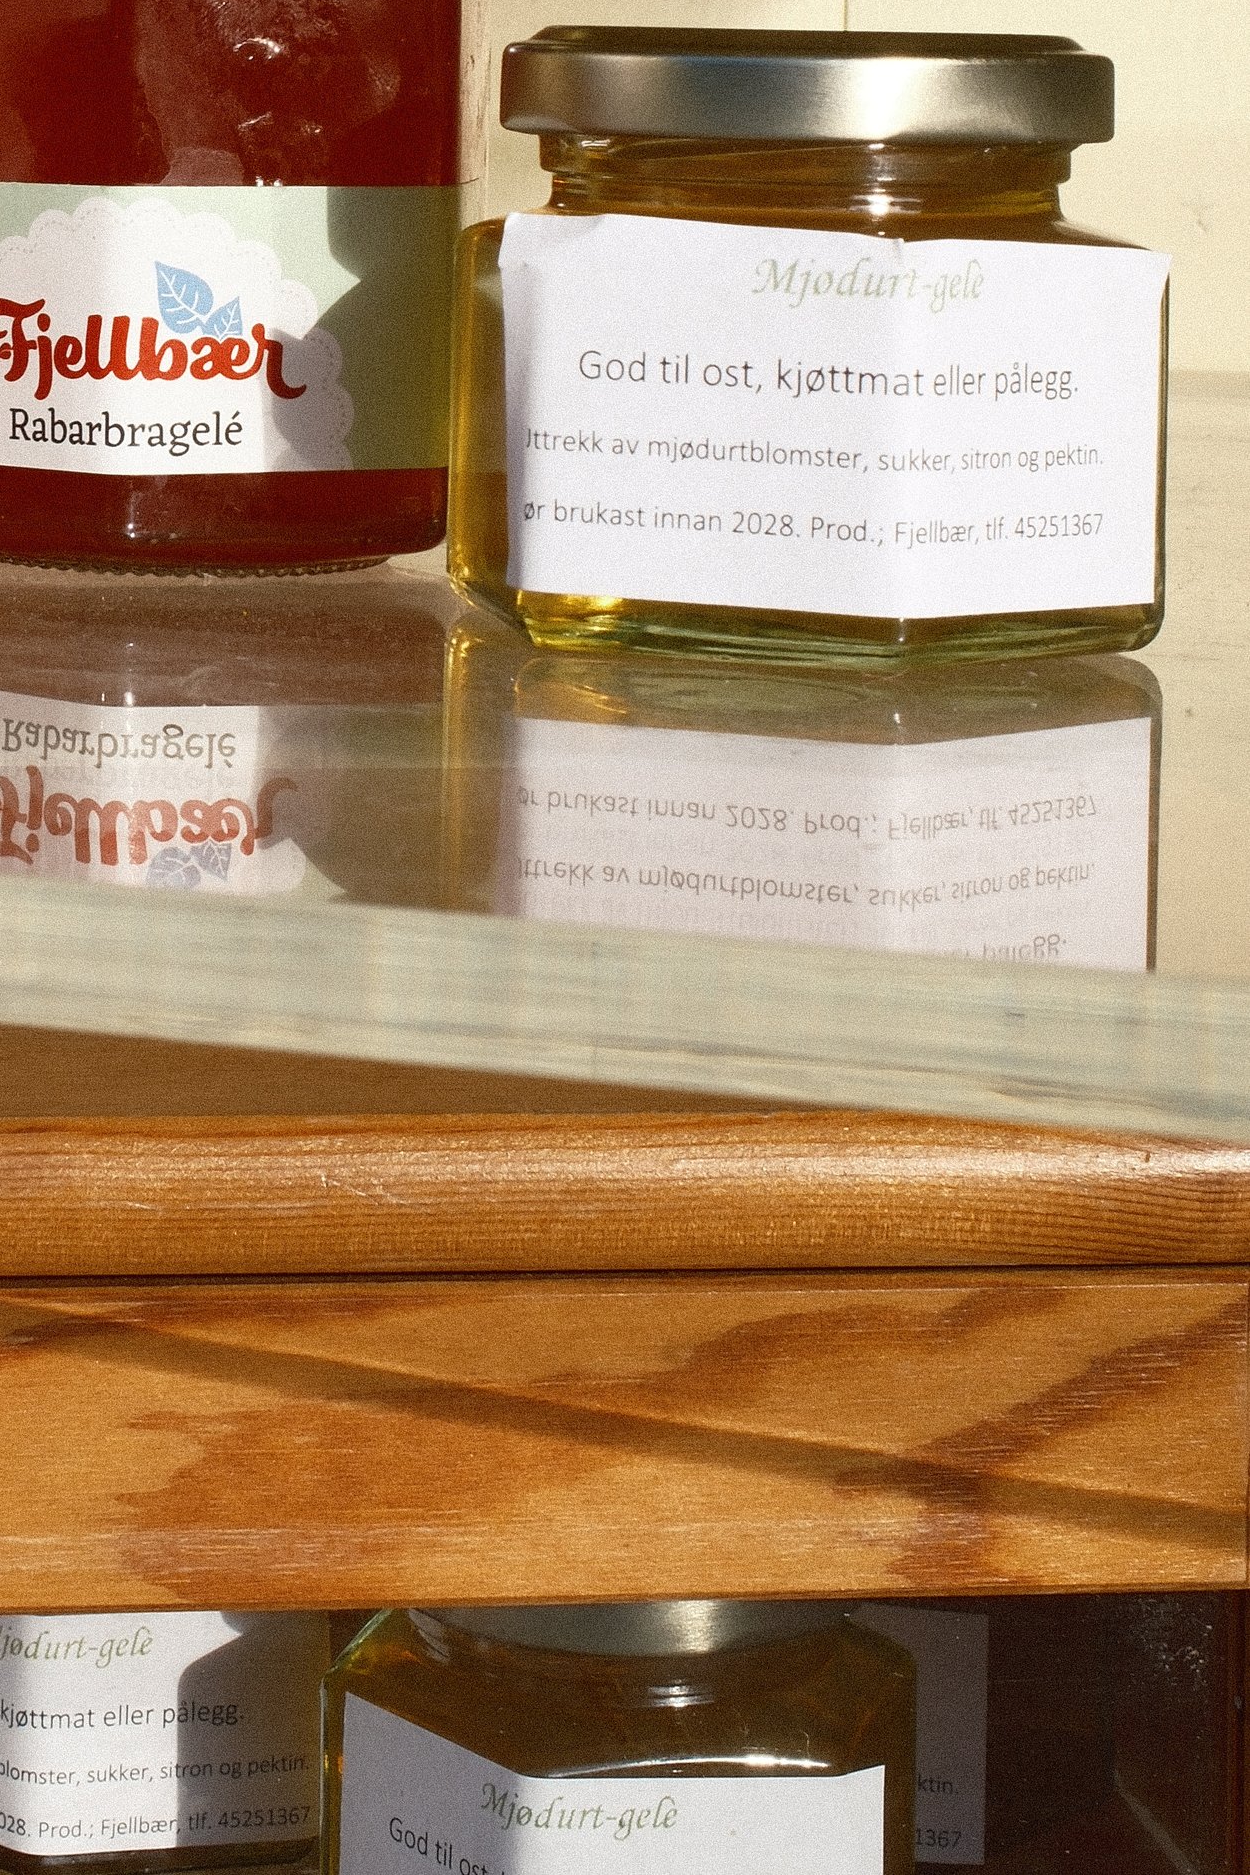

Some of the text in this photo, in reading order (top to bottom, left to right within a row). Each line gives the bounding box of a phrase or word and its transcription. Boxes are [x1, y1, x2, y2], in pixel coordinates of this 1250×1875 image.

[579, 350, 1079, 402] God til ost, kjøttmat eller pålegg.
[8, 407, 243, 457] Rabarbragelé
[612, 437, 639, 456] av
[648, 437, 868, 474] mjødurtblomster,
[878, 448, 956, 475] sukker,
[960, 448, 1012, 470] sitron
[1017, 449, 1040, 473] og
[1044, 443, 1104, 472] pektin.
[524, 498, 1104, 550] ør brukast innan 2028. Prod.; Fjellbær, tlf. 45251367
[1, 1698, 95, 1730] kjøttmat
[103, 1704, 155, 1727] eller
[163, 1701, 245, 1729] pålegg.
[87, 1764, 154, 1785] sukker,
[160, 1759, 214, 1780] sitron
[219, 1760, 242, 1781] og
[248, 1753, 310, 1777] pektin.
[39, 1820, 94, 1841] Prod.;
[101, 1815, 181, 1840] Fjellbær,
[188, 1811, 213, 1831] tlf.
[218, 1806, 311, 1829] 45251367
[389, 1817, 427, 1856] God
[435, 1840, 452, 1870] til
